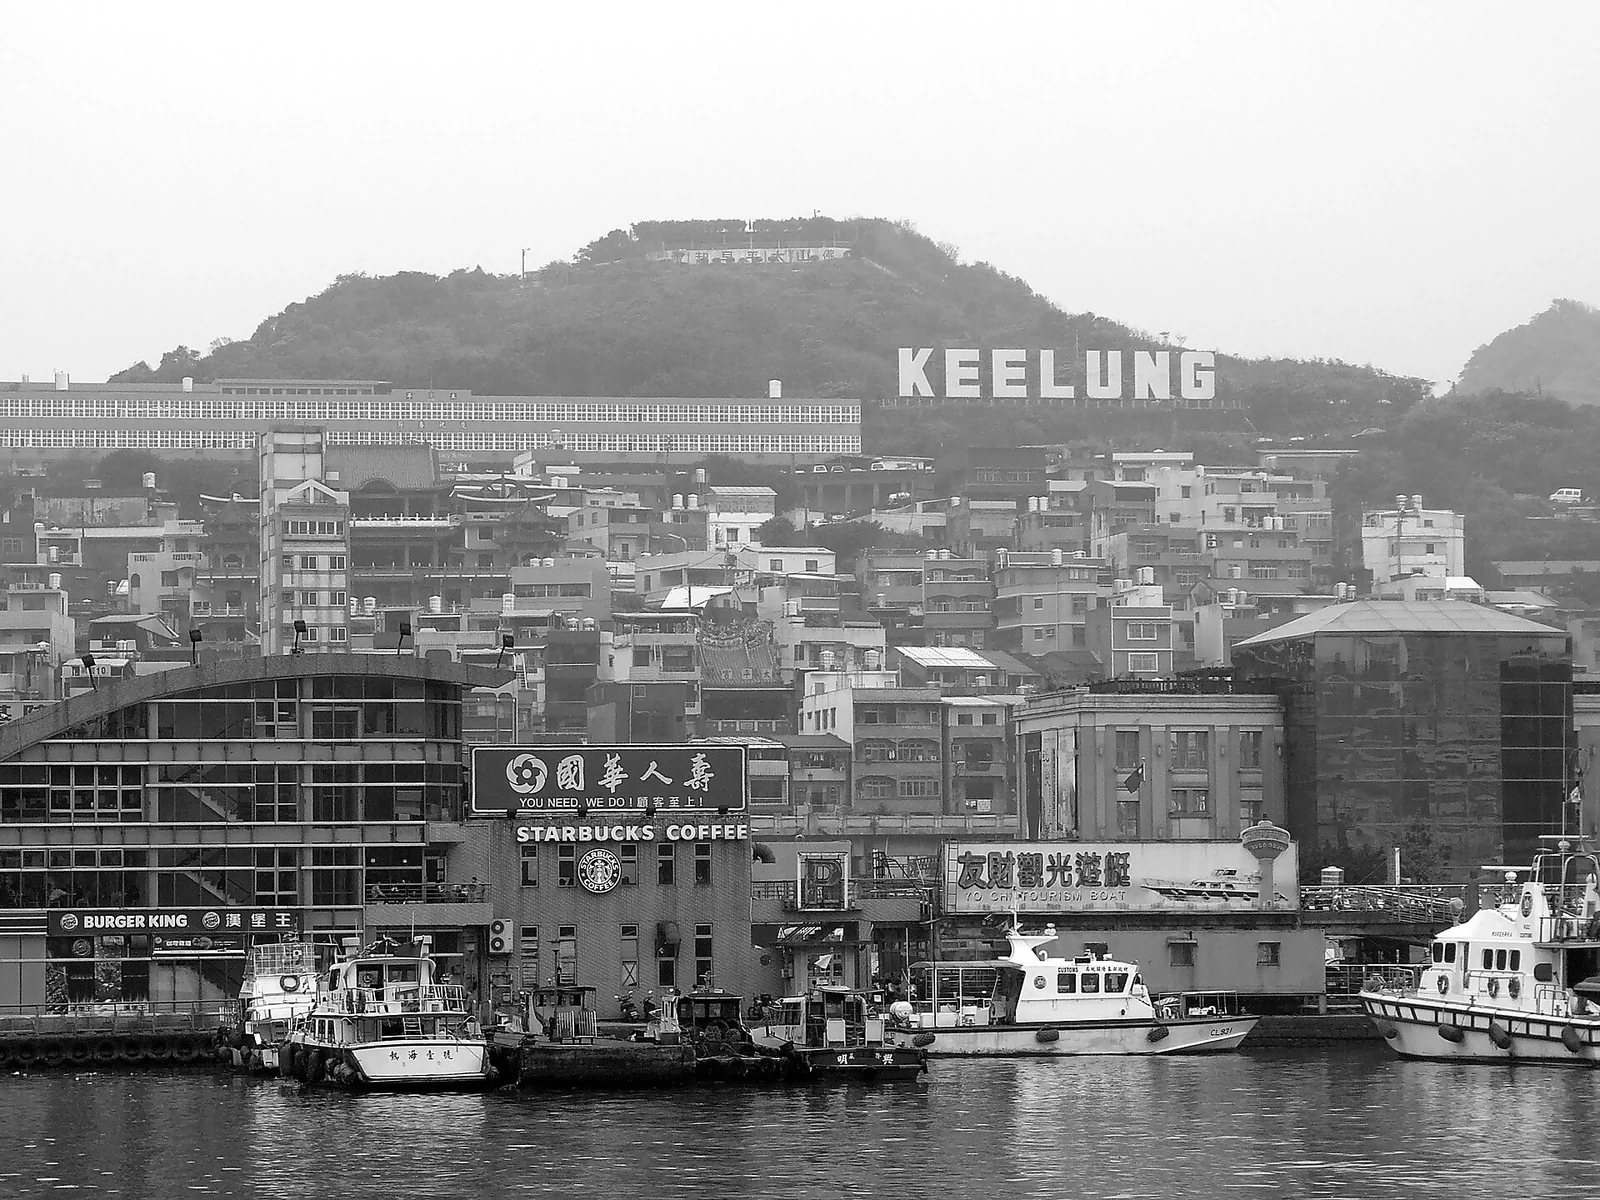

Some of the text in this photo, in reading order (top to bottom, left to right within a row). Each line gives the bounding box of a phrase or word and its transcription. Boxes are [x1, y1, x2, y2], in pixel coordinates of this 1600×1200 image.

[898, 347, 1215, 400] KEELUNG
[556, 752, 716, 794] 國華人壽
[519, 797, 543, 808] YOU
[585, 797, 604, 807] WE
[516, 824, 748, 843] STARBUCKS COFFEE
[581, 850, 619, 870] STARBUCKS
[958, 851, 1131, 889] 友財觀光遊艇
[584, 879, 615, 890] COFFEE
[965, 890, 983, 902] YO
[1089, 891, 1126, 902] BOAT
[83, 914, 189, 929] BURGER KING
[226, 912, 291, 928] 漢堡王
